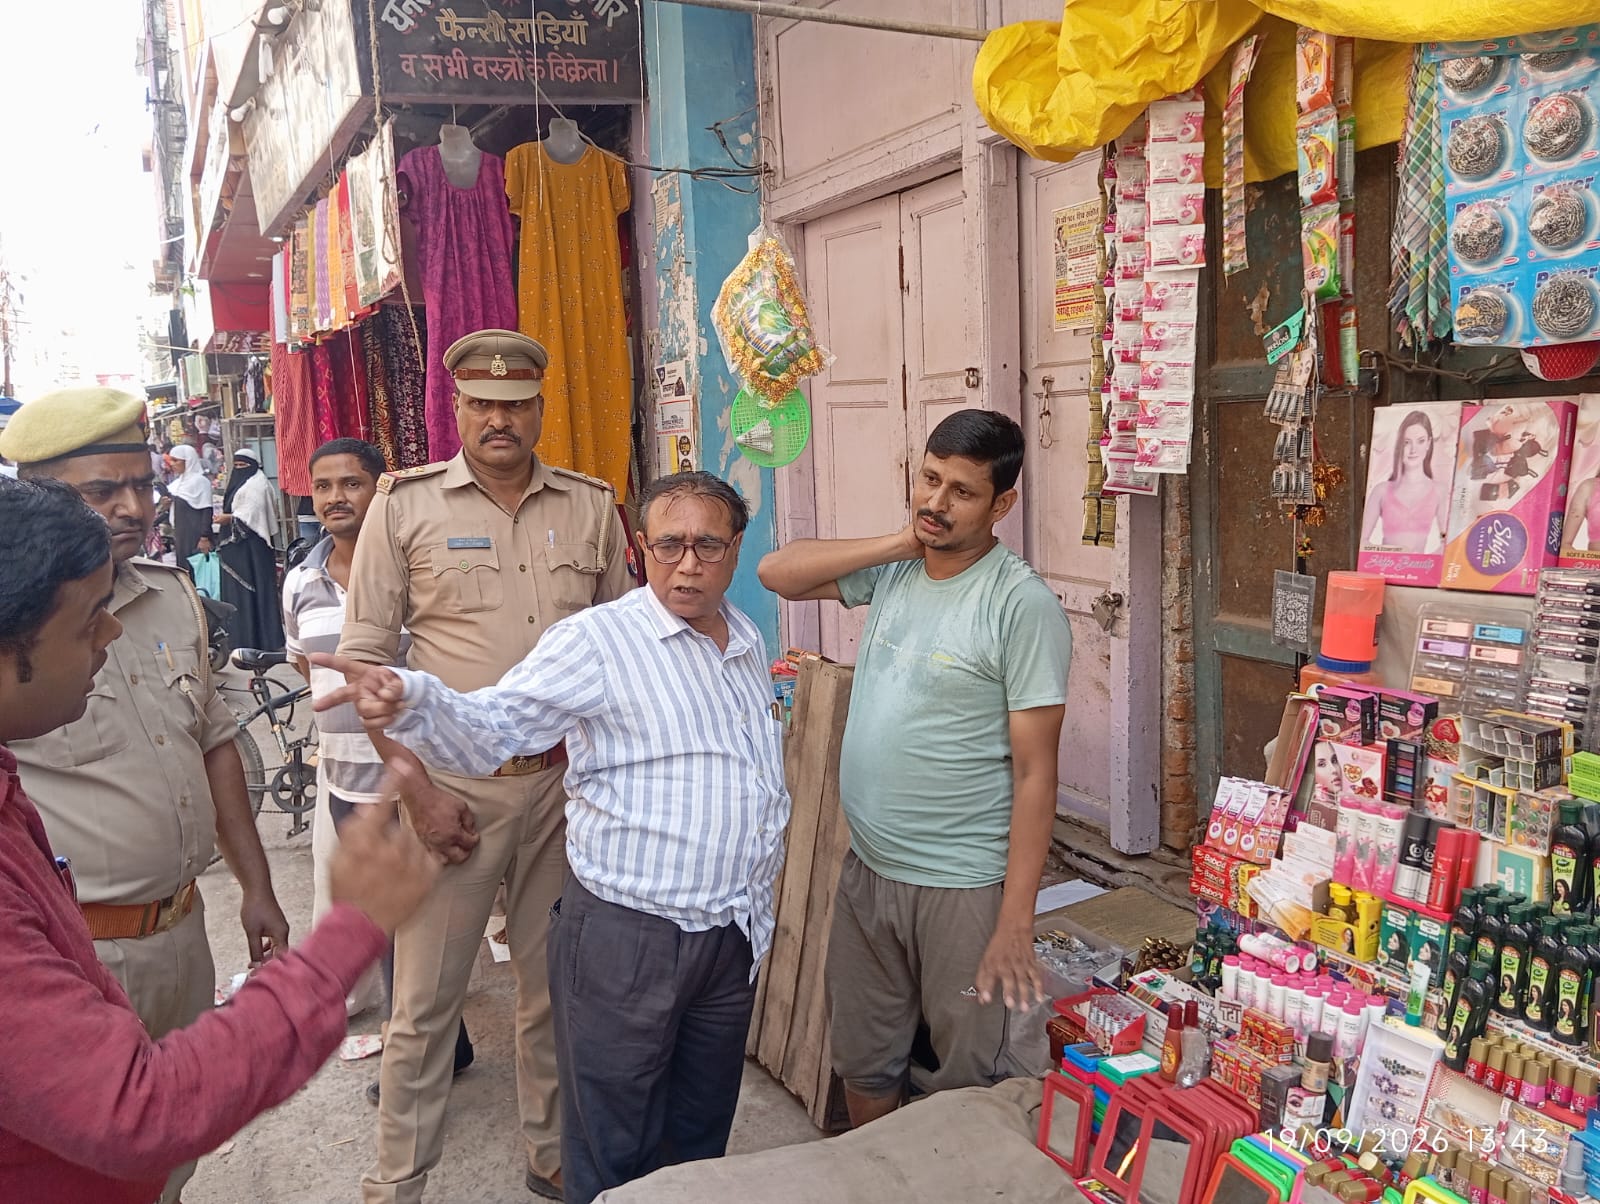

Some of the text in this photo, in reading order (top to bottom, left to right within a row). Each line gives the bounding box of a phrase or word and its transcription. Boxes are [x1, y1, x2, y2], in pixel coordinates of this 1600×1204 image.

[399, 53, 417, 78] व
[422, 48, 469, 81] सभी
[1489, 519, 1511, 567] Shifa
